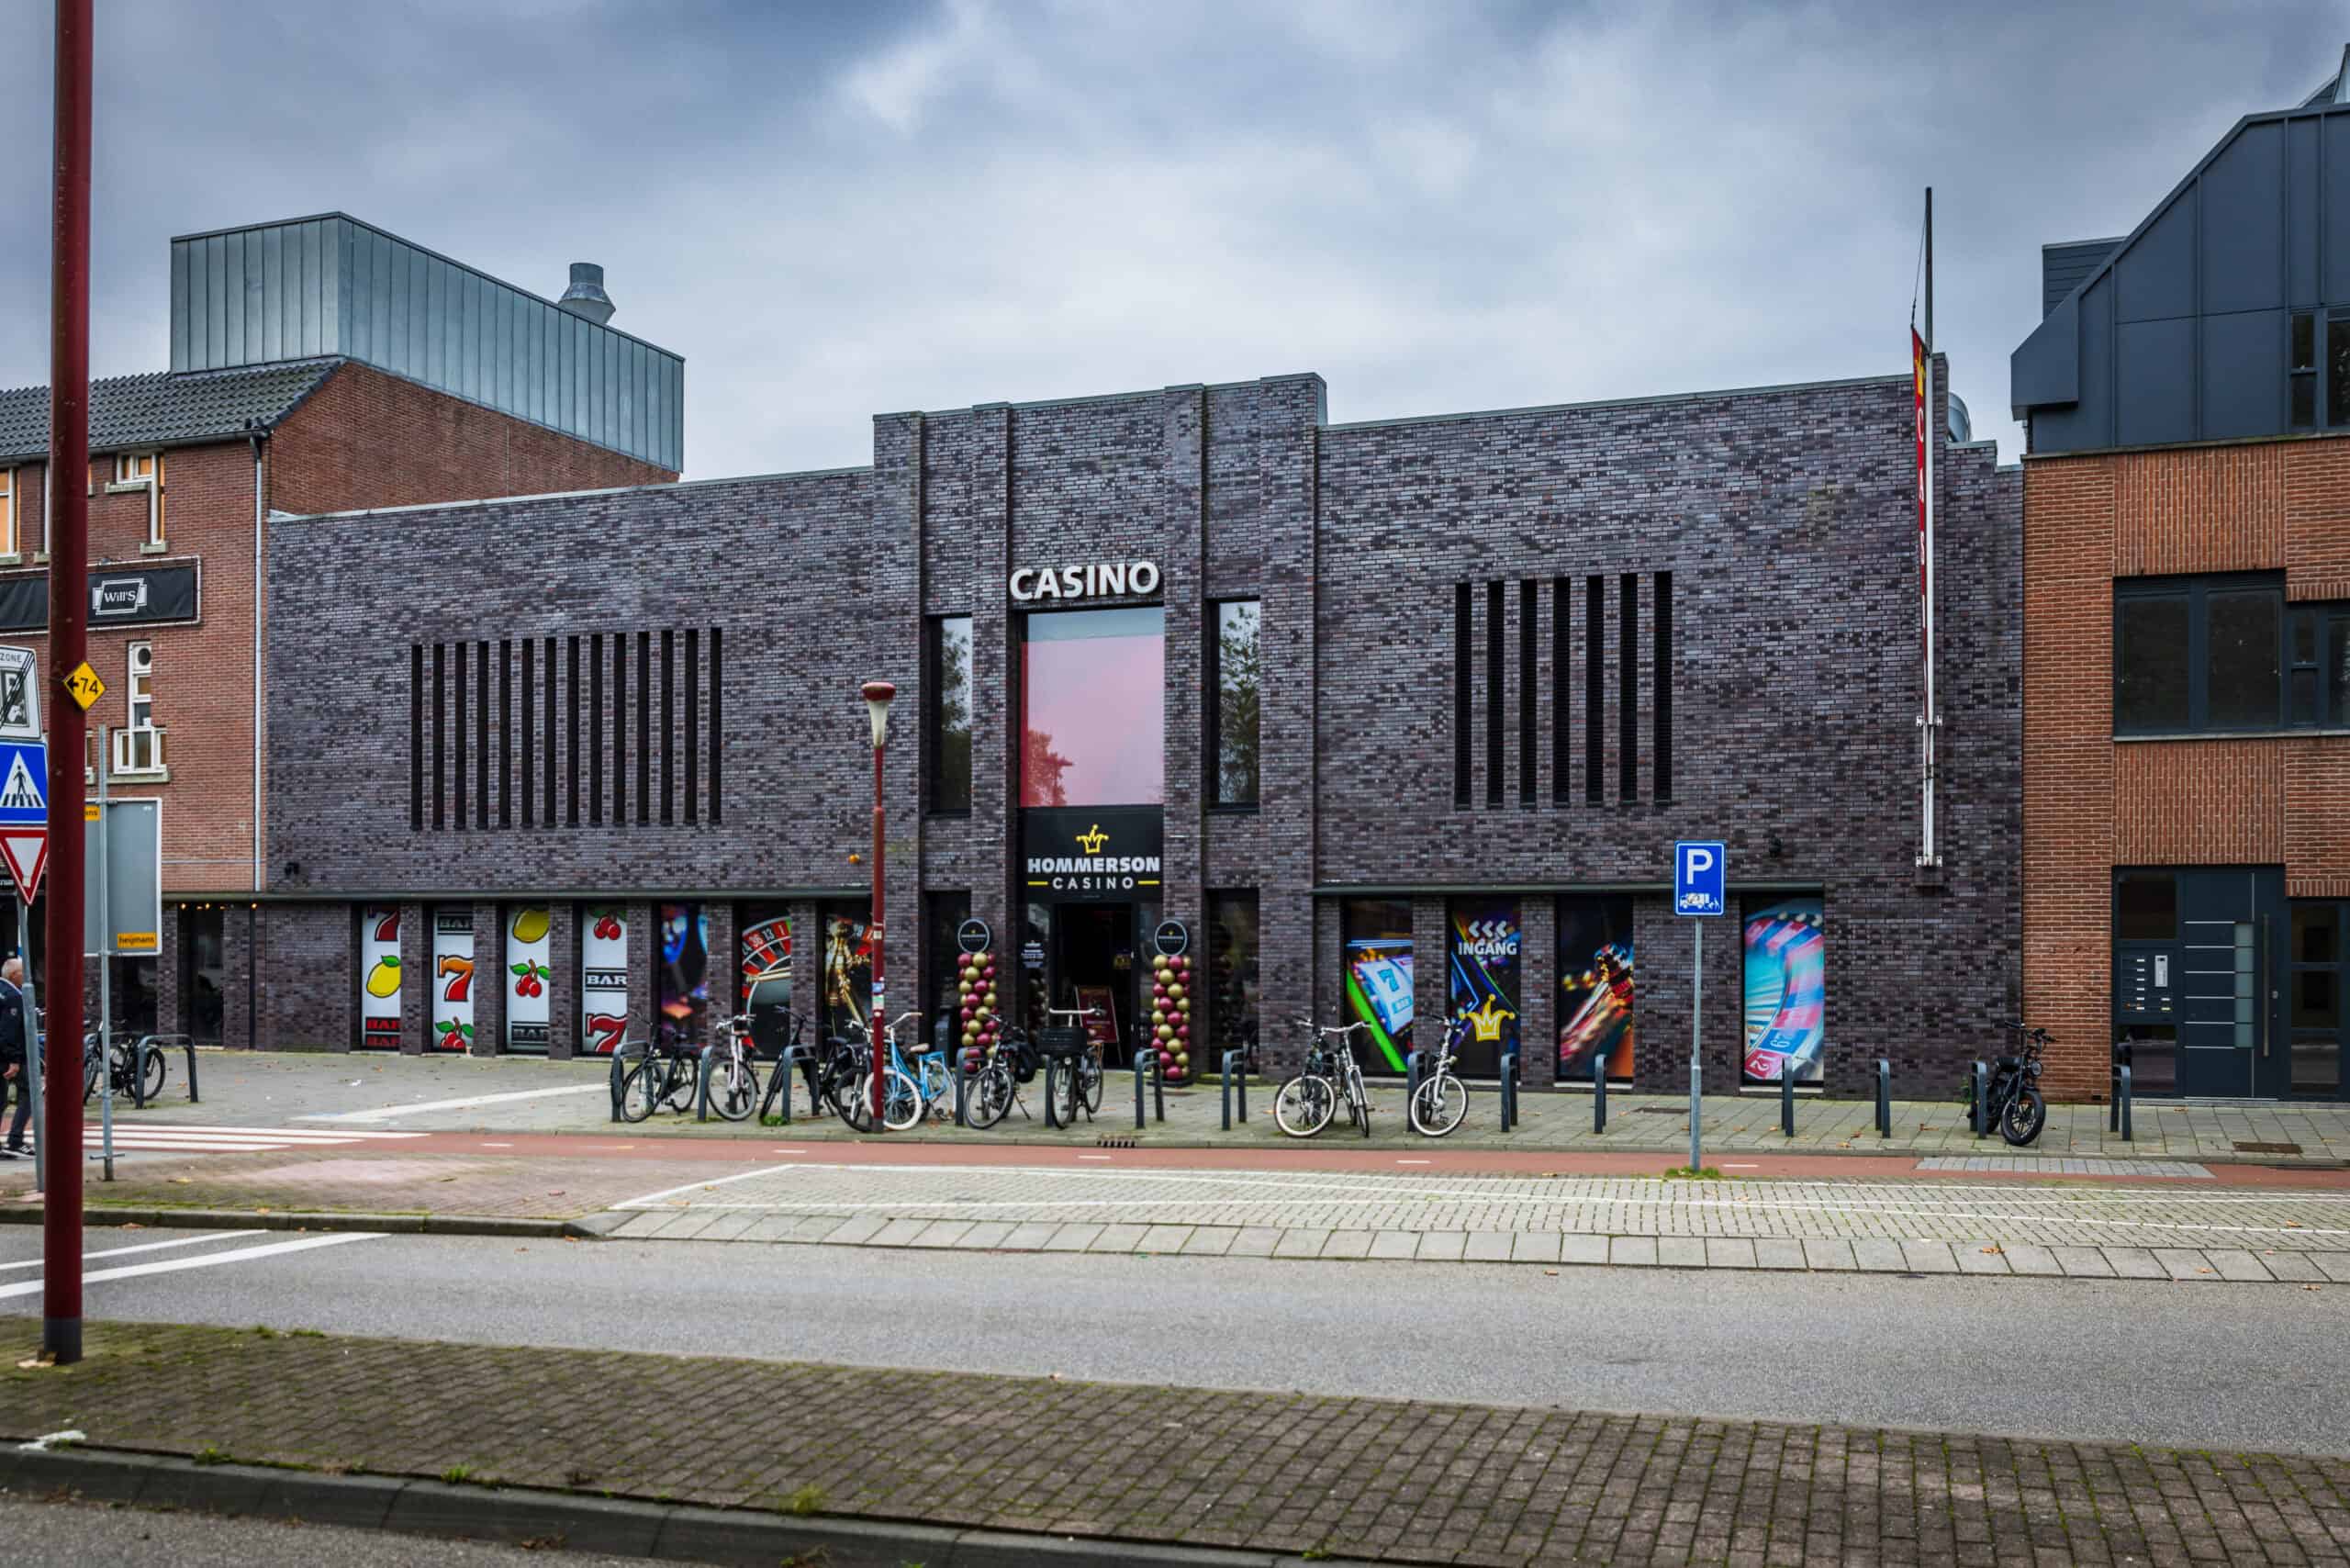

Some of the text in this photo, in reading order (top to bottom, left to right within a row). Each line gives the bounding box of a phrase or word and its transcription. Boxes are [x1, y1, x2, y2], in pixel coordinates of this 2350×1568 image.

[1010, 561, 1159, 601] CASINO
[0, 653, 22, 663] ZONE
[80, 678, 99, 695] 74
[1028, 857, 1159, 873] HOMMERSON
[1686, 849, 1713, 885] P
[1052, 877, 1134, 890] CASINO
[1458, 942, 1517, 956] INGANG
[437, 954, 475, 1002] 7
[587, 975, 628, 985] BAR
